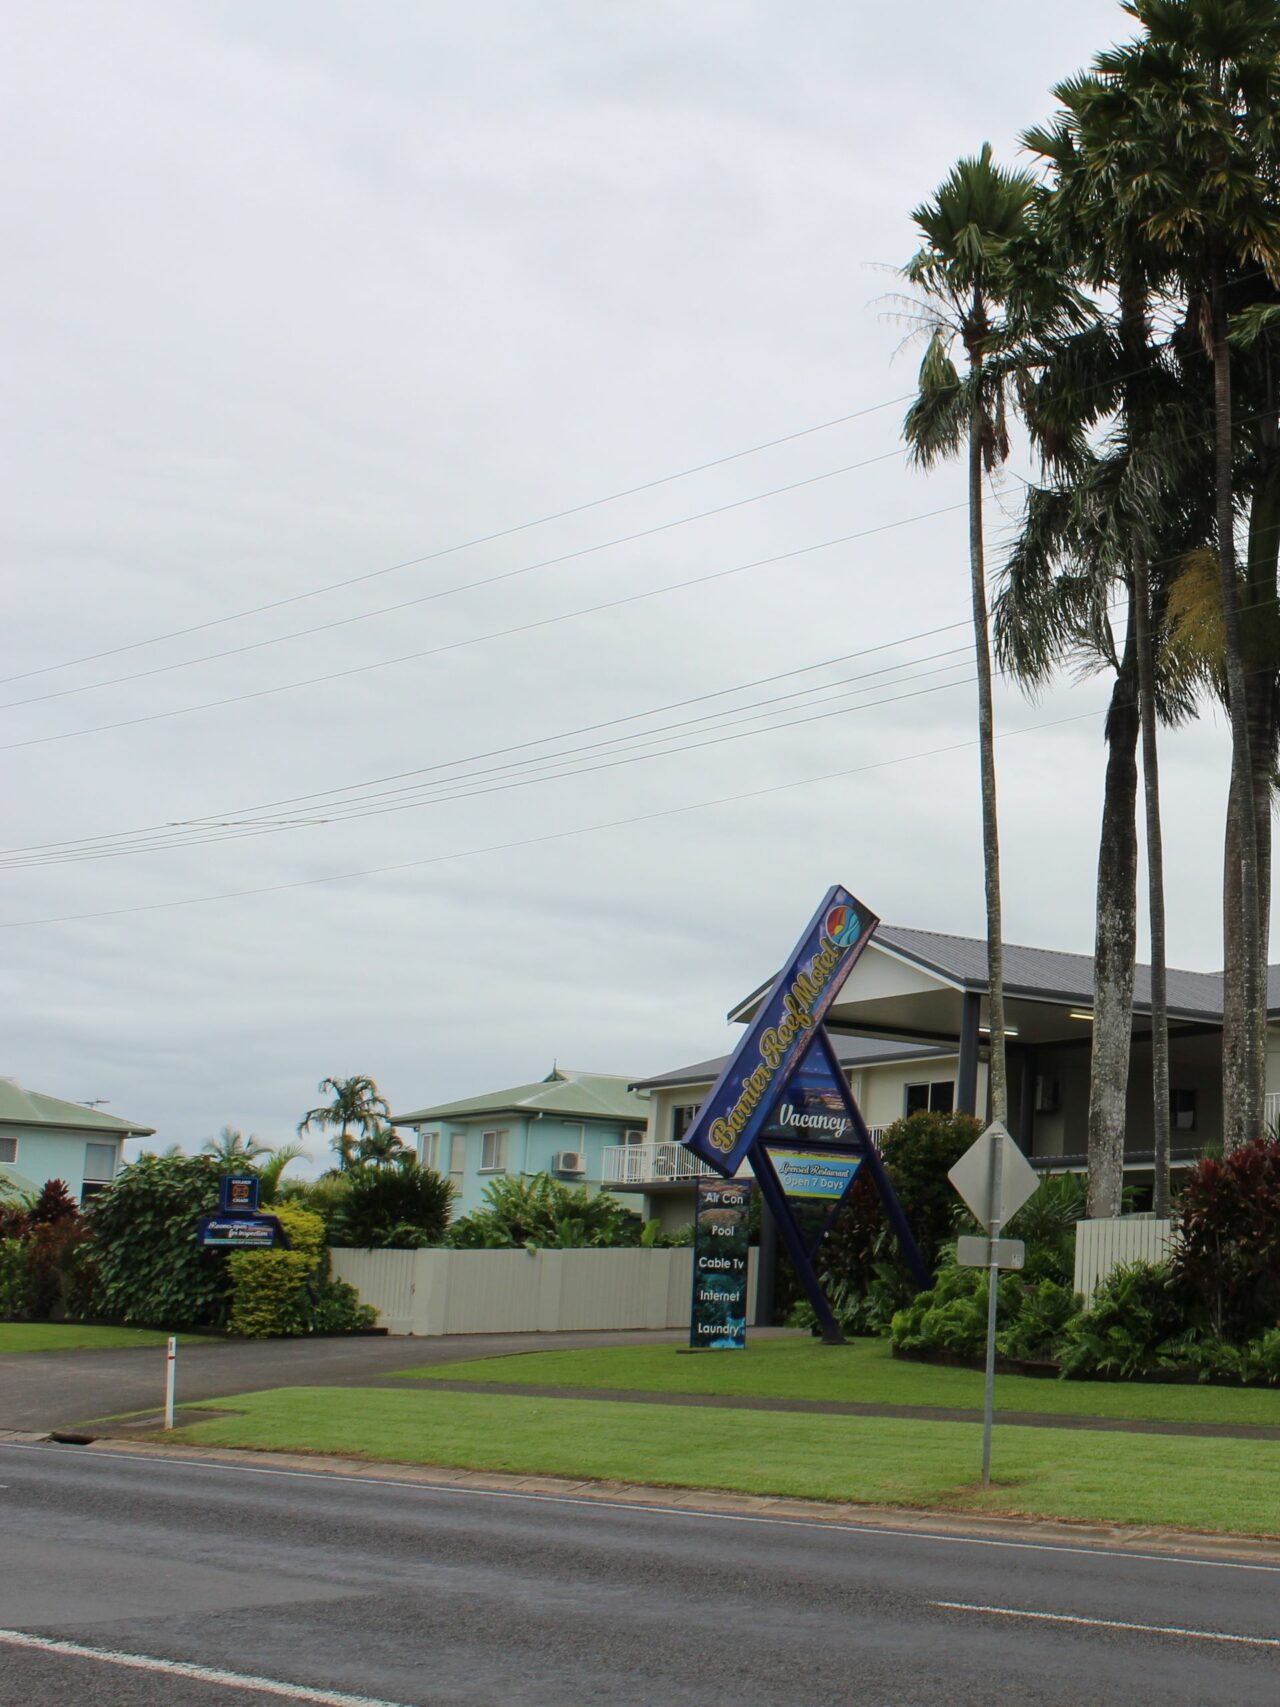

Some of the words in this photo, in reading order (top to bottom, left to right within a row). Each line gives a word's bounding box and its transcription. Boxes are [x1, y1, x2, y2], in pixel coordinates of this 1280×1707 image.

[709, 1063, 771, 1153] Barrier
[759, 994, 813, 1069] Reef
[792, 936, 840, 1008] Motel
[780, 1104, 847, 1138] Vacancy
[779, 1161, 809, 1175] Licensed
[810, 1163, 850, 1178] Restaurant
[783, 1175, 810, 1187] Open
[812, 1177, 818, 1186] 7
[821, 1179, 844, 1190] Days
[705, 1192, 720, 1203] Air
[722, 1193, 744, 1204] Con
[712, 1225, 735, 1236] Pool
[699, 1256, 731, 1269] Cable
[733, 1258, 744, 1269] Tv
[700, 1290, 740, 1302] Internet
[698, 1323, 739, 1337] Laundry
